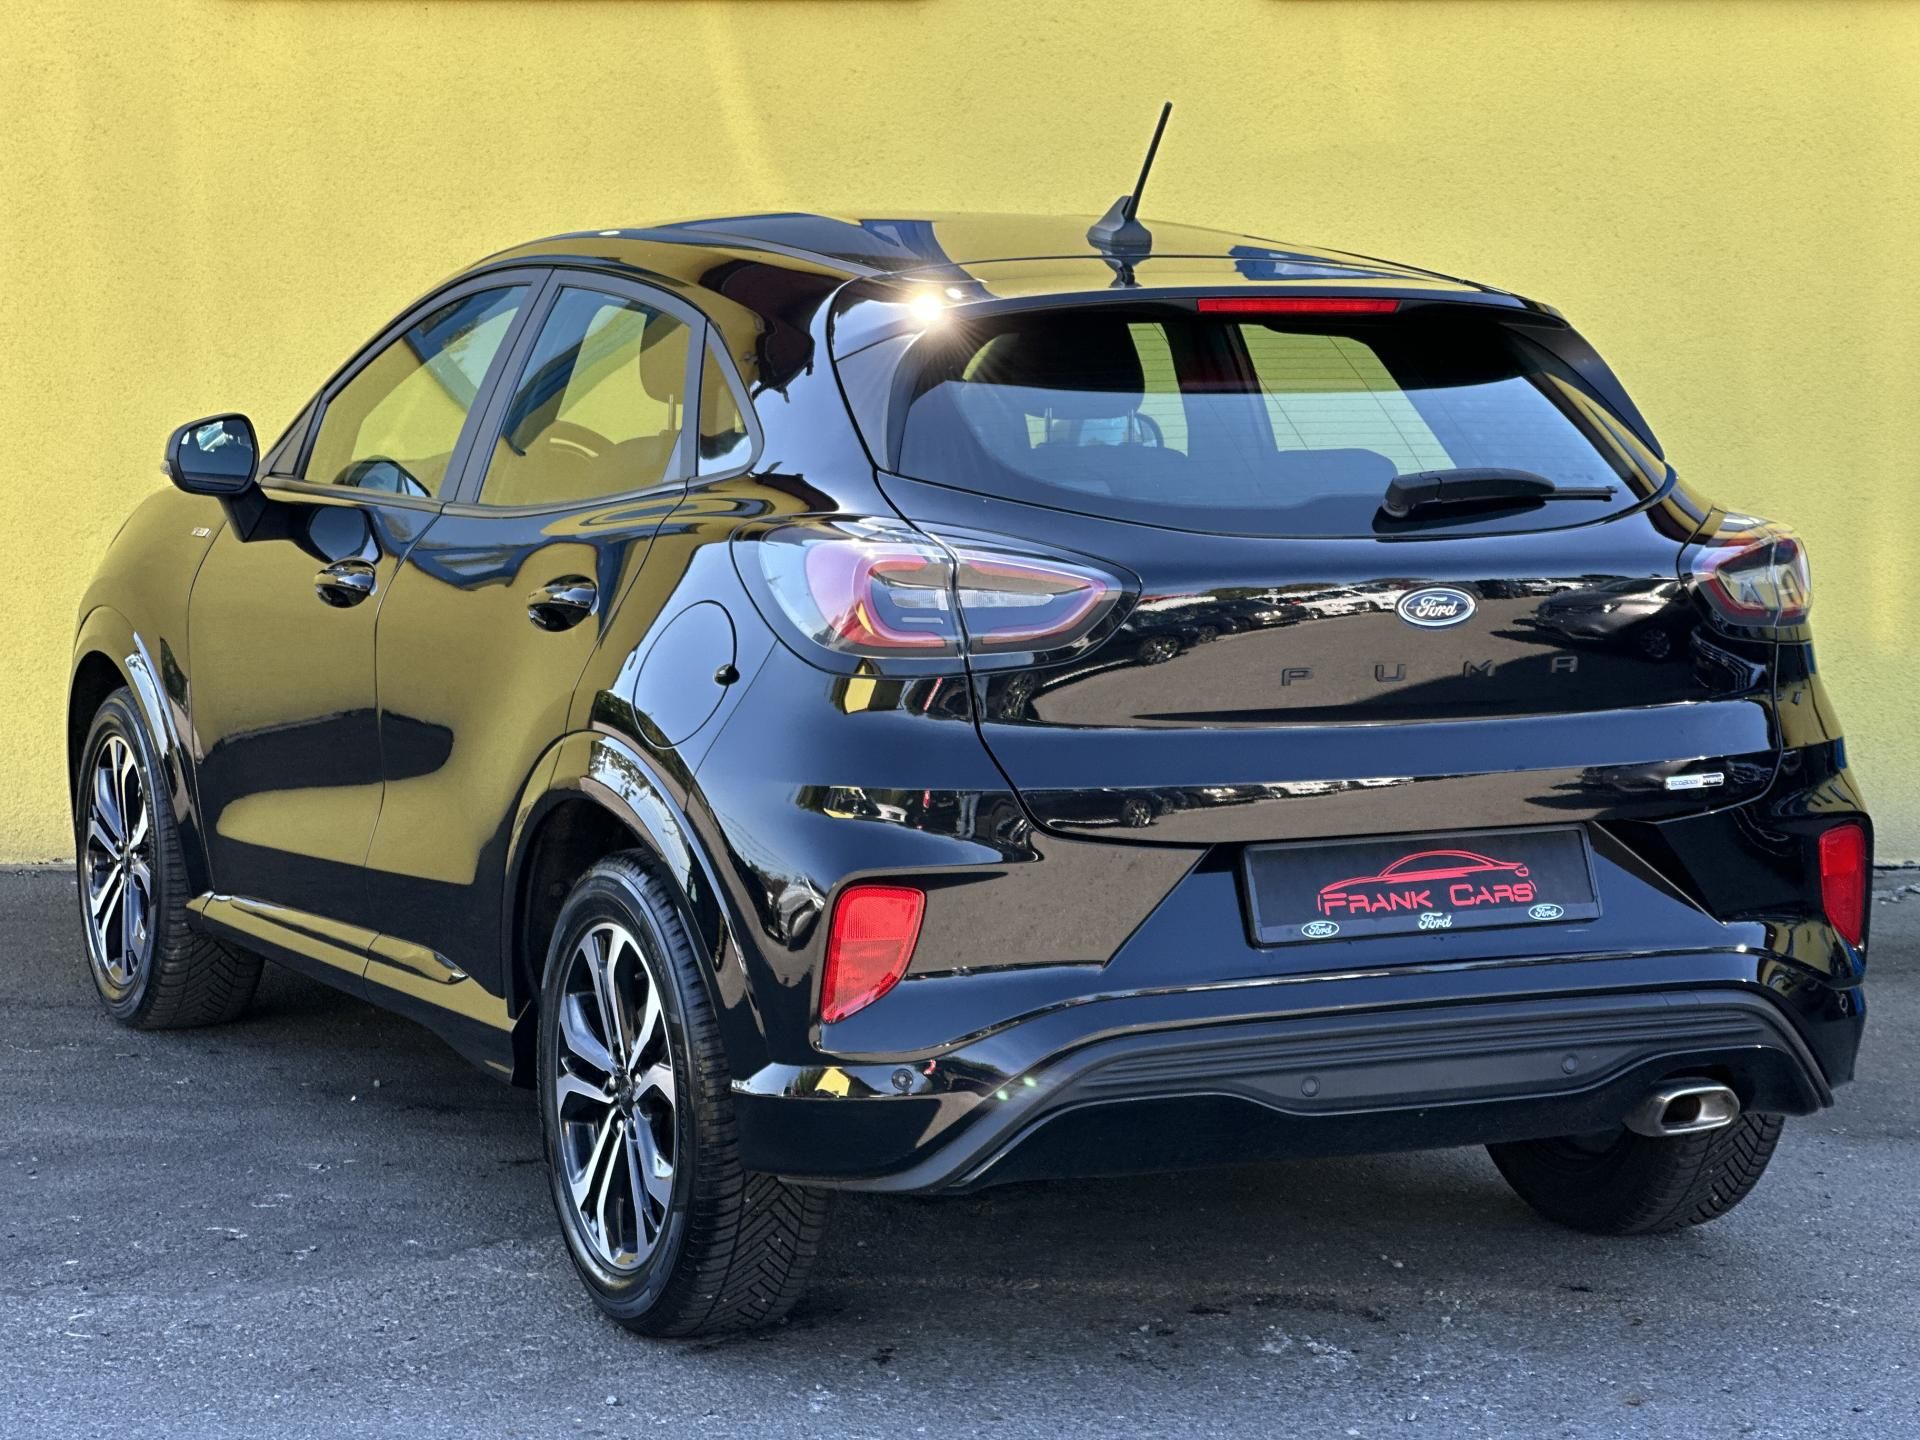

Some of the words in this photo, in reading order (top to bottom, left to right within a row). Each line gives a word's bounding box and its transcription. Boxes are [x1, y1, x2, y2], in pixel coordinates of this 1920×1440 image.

[1416, 596, 1457, 618] Ford
[1281, 655, 1579, 687] PUMA
[1323, 890, 1434, 916] FRANK
[1449, 883, 1534, 907] CARS
[1418, 912, 1453, 930] Ford
[1534, 906, 1557, 918] Ford
[1307, 923, 1334, 936] Ford
